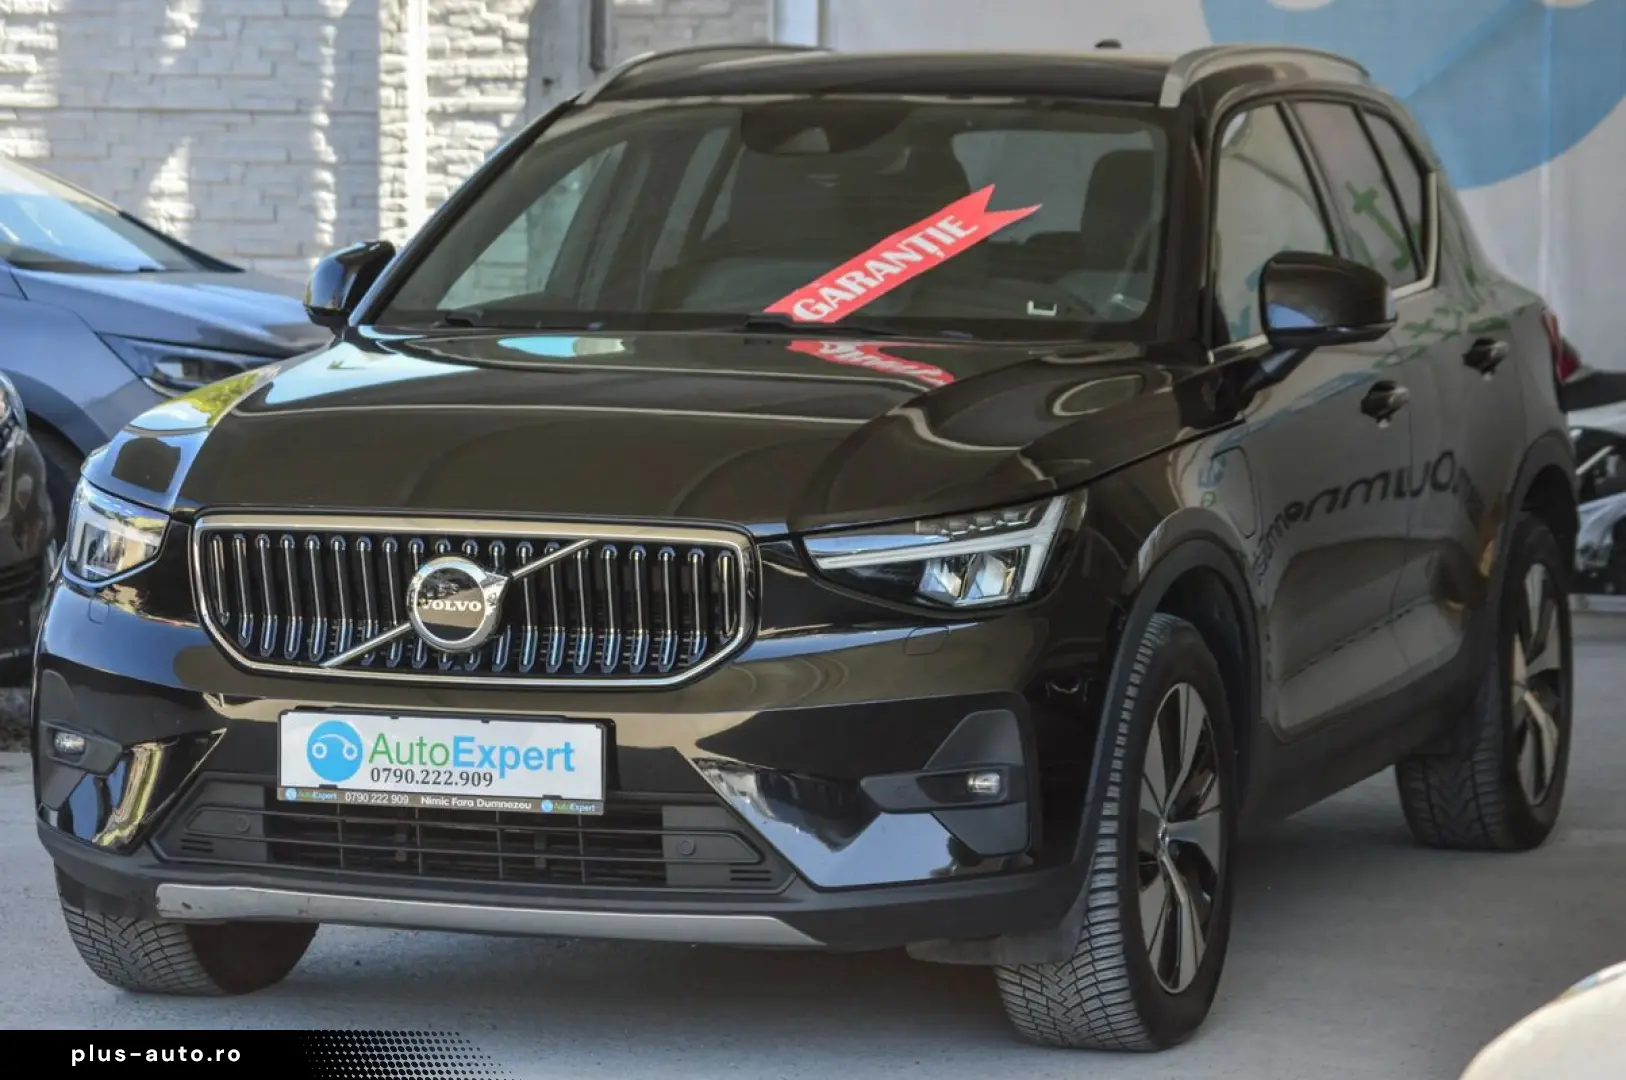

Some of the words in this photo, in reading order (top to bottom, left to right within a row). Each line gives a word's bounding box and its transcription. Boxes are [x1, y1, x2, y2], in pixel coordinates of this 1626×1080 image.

[421, 599, 482, 612] VOLVO
[368, 732, 575, 779] AutoExpert
[370, 767, 493, 788] 0790.222.909
[345, 791, 368, 803] 0790
[371, 793, 389, 804] 222
[391, 794, 409, 804] 909
[421, 795, 450, 807] Nimic
[452, 797, 474, 808] Fara
[477, 798, 532, 810] Dumnezeu
